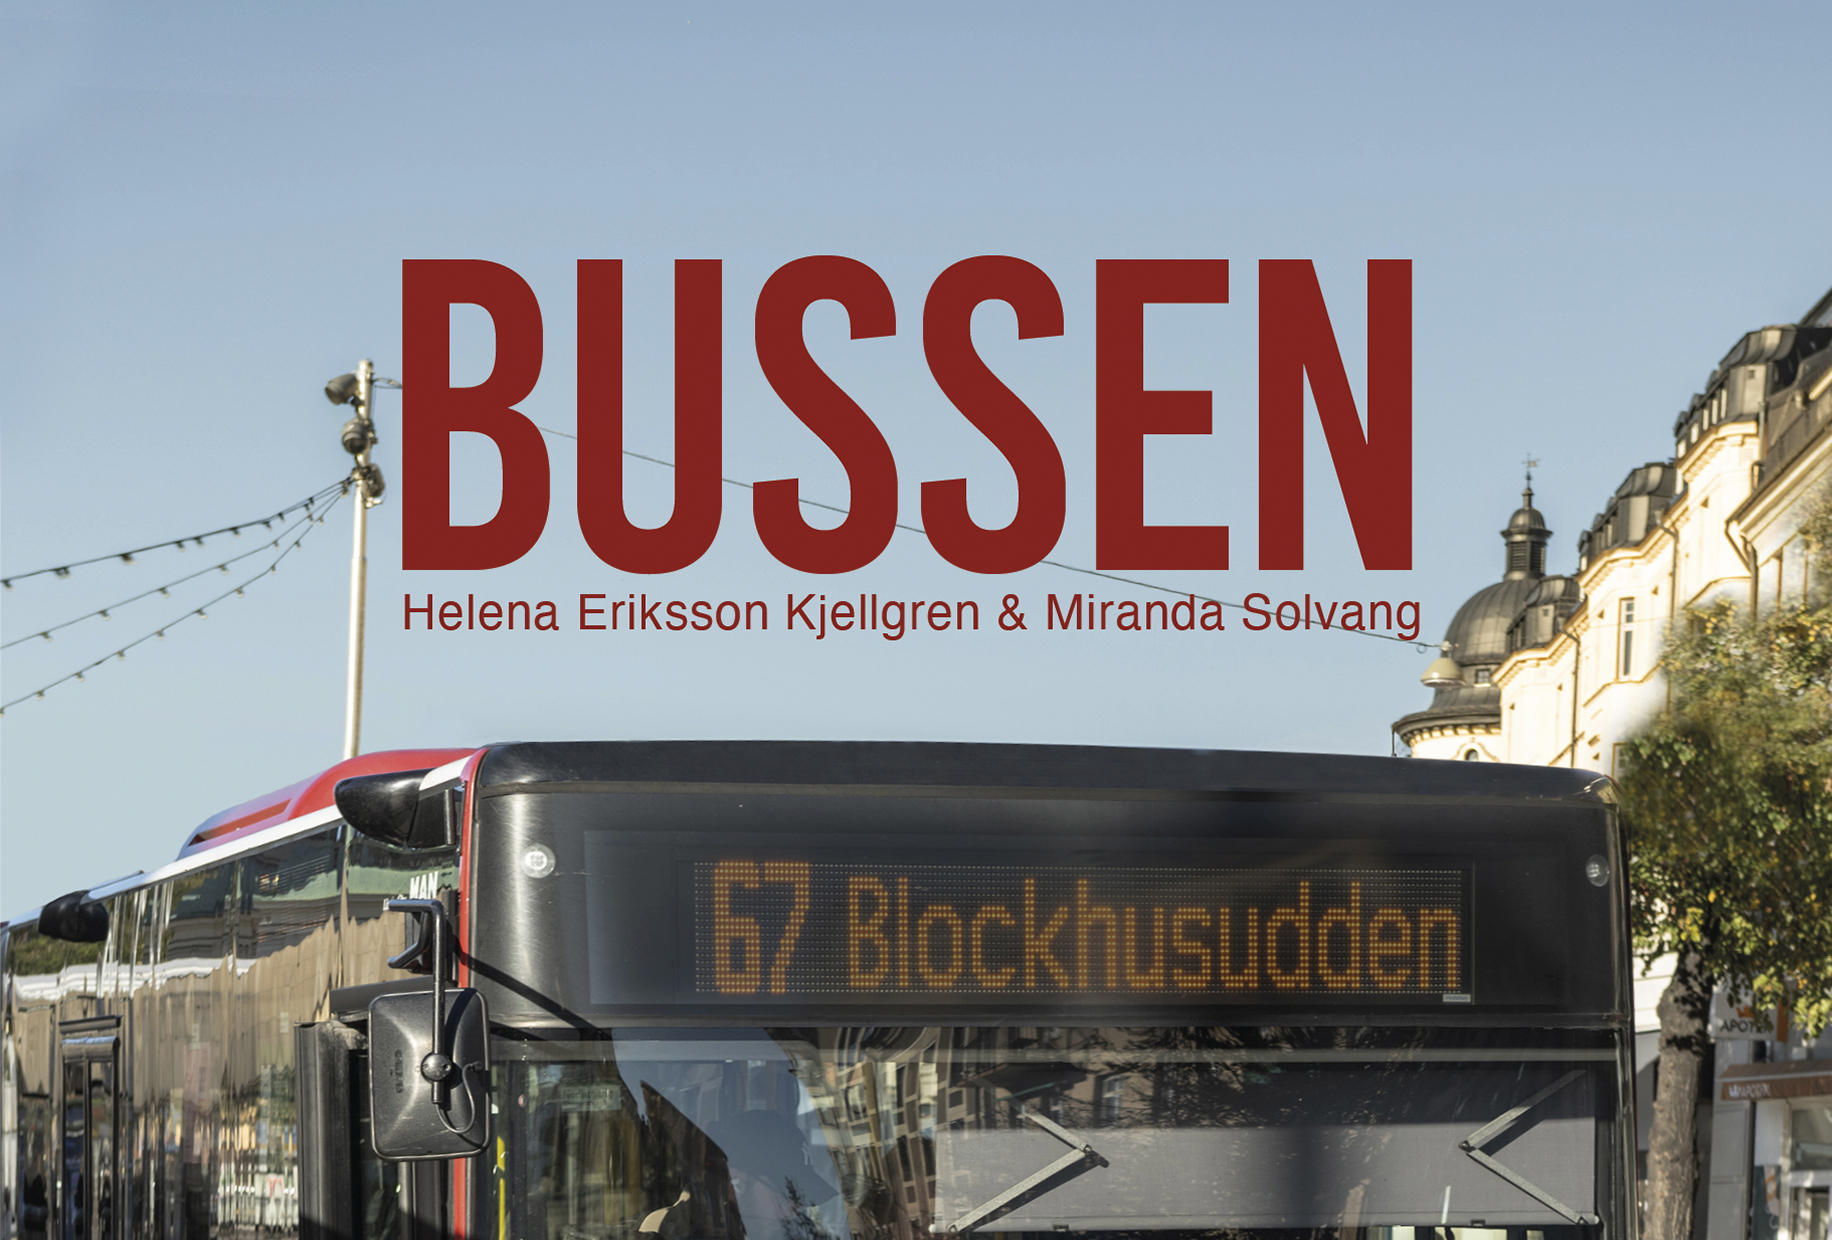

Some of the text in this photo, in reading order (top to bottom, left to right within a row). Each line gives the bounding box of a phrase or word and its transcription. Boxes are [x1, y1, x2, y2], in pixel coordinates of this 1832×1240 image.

[409, 871, 438, 900] MAN
[714, 861, 1457, 994] 67 Blockhusudden
